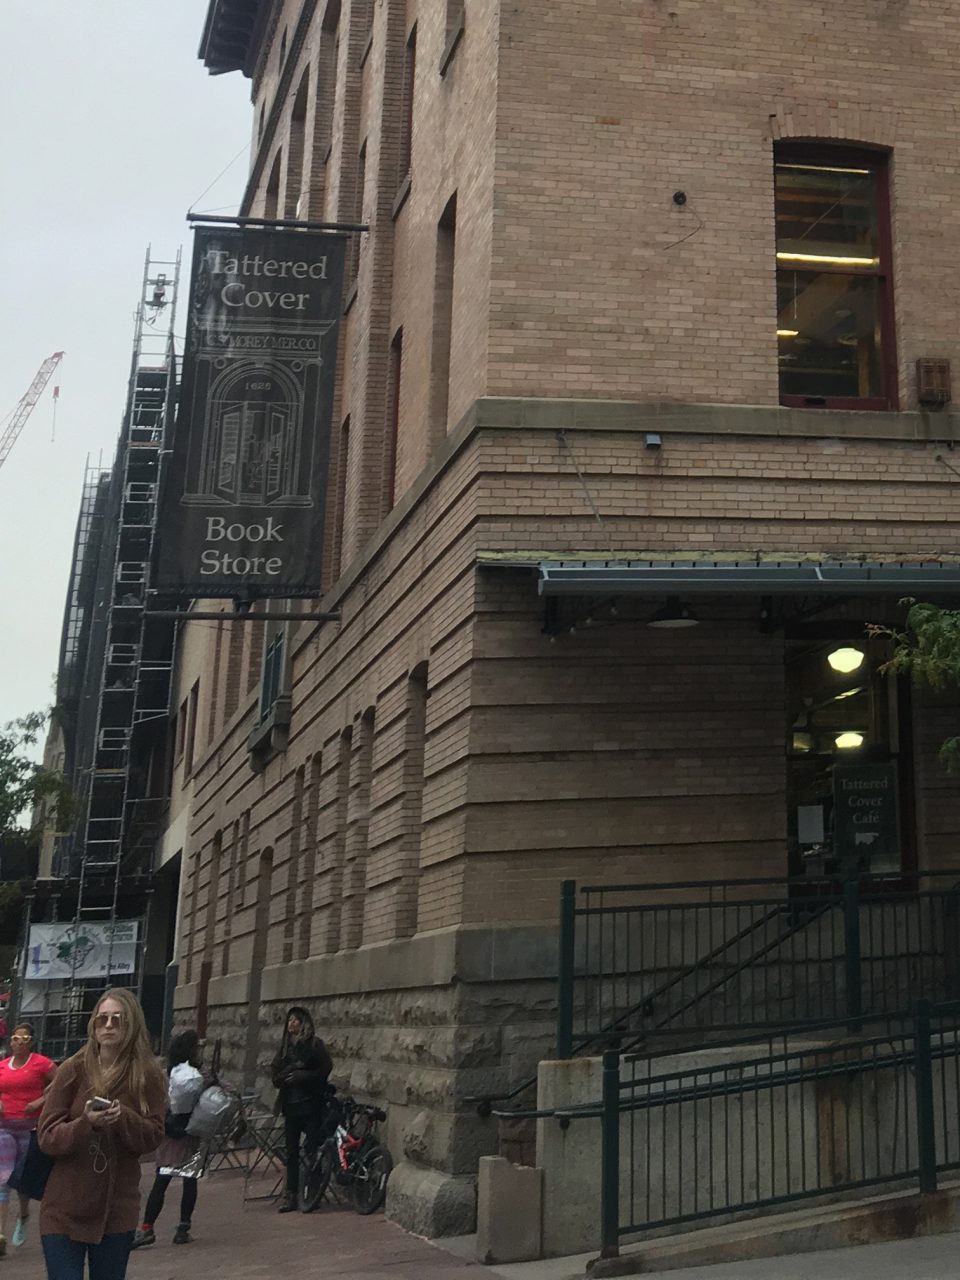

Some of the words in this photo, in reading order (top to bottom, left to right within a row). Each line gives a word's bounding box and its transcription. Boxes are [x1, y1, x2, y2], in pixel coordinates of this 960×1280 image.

[206, 250, 328, 279] Tattered
[220, 282, 310, 310] Cover
[205, 516, 284, 541] Book
[200, 549, 282, 575] Store
[841, 775, 888, 789] Tattered
[848, 794, 883, 807] Cover
[852, 809, 880, 824] Café
